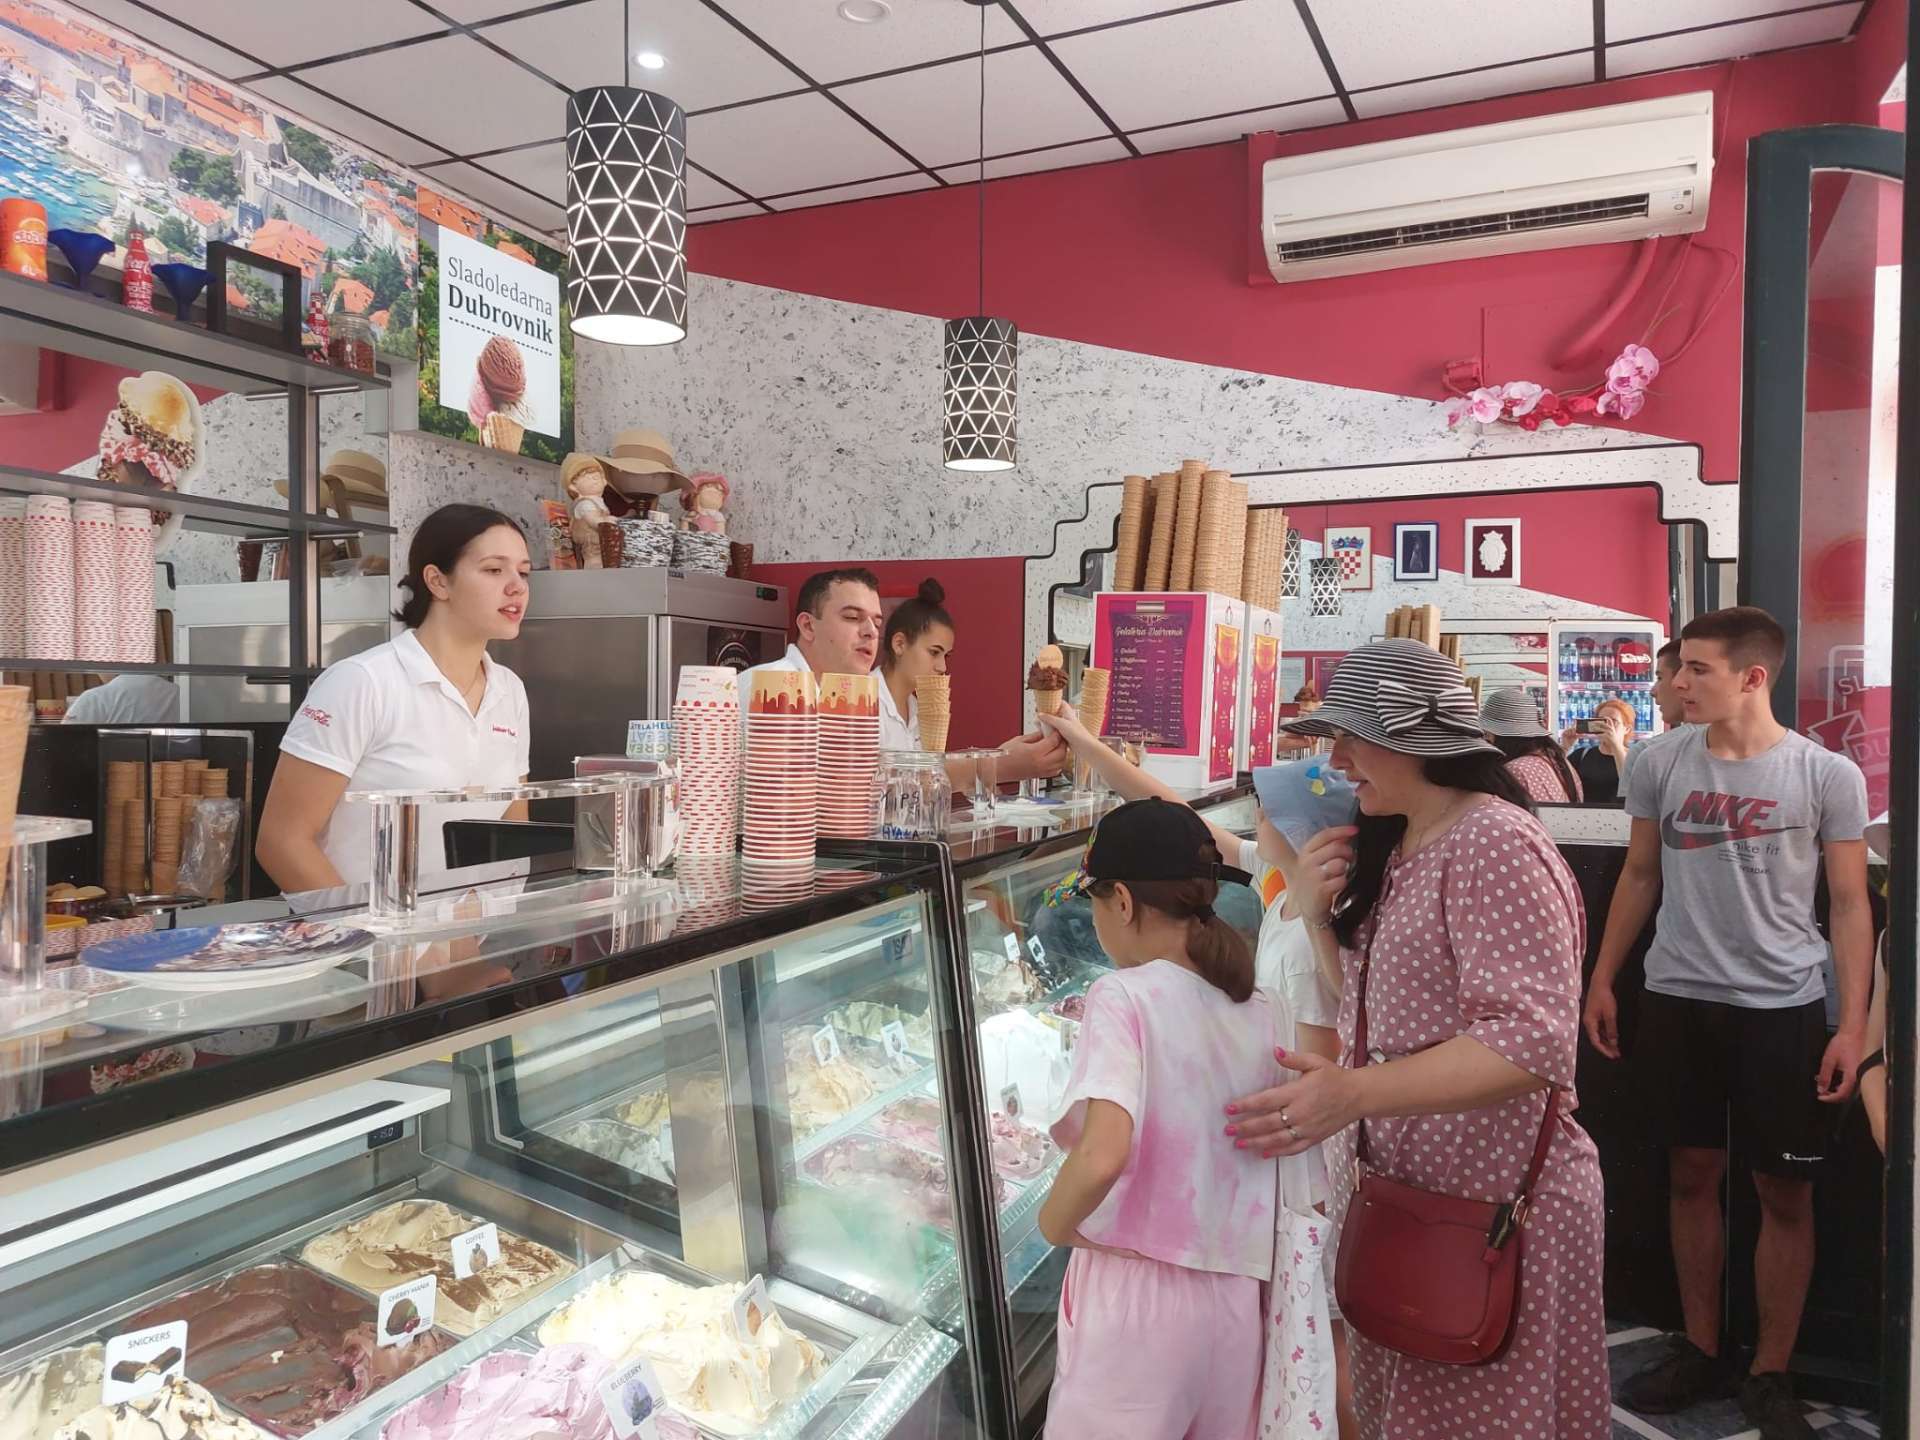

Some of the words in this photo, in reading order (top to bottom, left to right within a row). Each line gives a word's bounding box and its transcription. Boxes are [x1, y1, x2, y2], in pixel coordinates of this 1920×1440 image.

[448, 256, 553, 317] Sladoledarna
[448, 283, 553, 344] Dubrovnik
[1675, 790, 1778, 831] NIKE
[1765, 842, 1781, 856] fit
[127, 1330, 171, 1349] SNICKERS
[610, 1363, 643, 1391] BLUEBERRY
